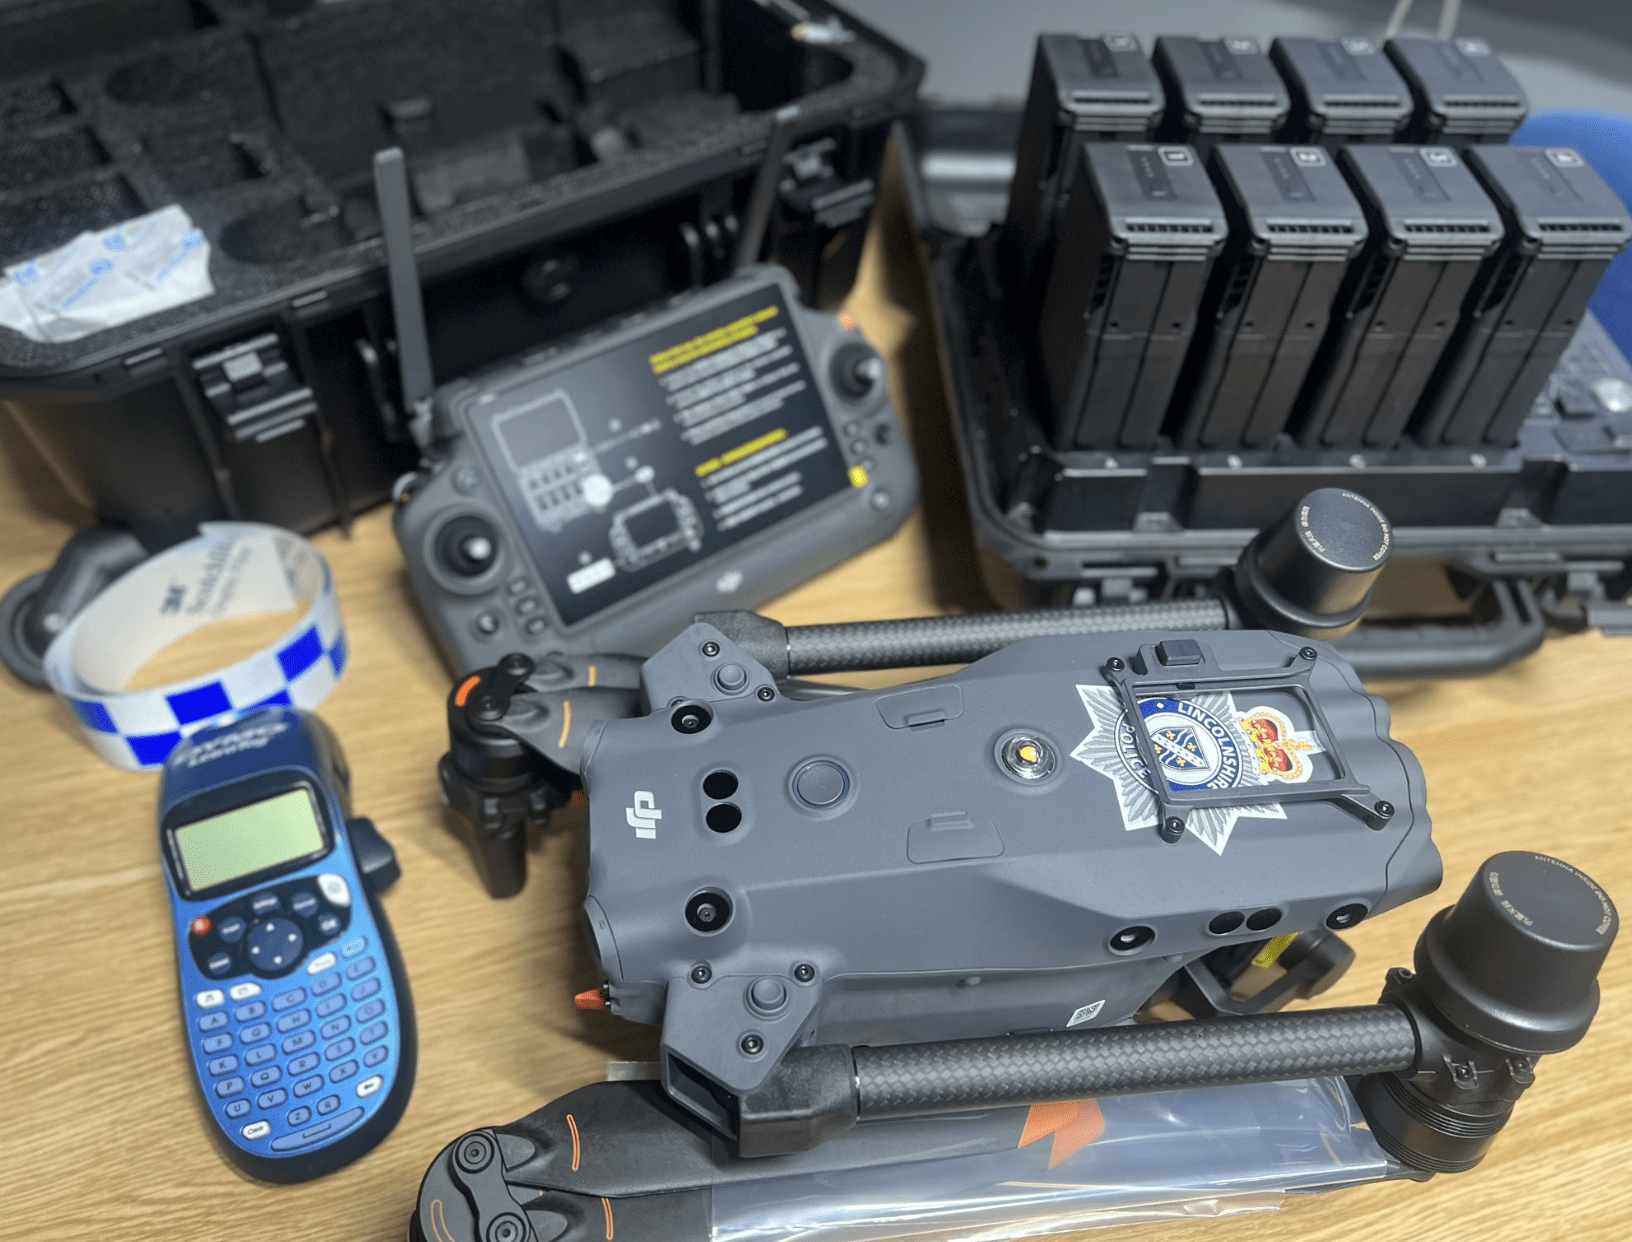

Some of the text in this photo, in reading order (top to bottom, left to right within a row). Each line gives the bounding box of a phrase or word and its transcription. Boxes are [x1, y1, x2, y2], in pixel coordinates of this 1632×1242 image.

[1342, 492, 1370, 508] ANTENNA
[1381, 523, 1388, 533] DO
[1372, 544, 1387, 560] COVER
[1120, 722, 1152, 779] POLICE
[1534, 855, 1573, 873] ANTENNA
